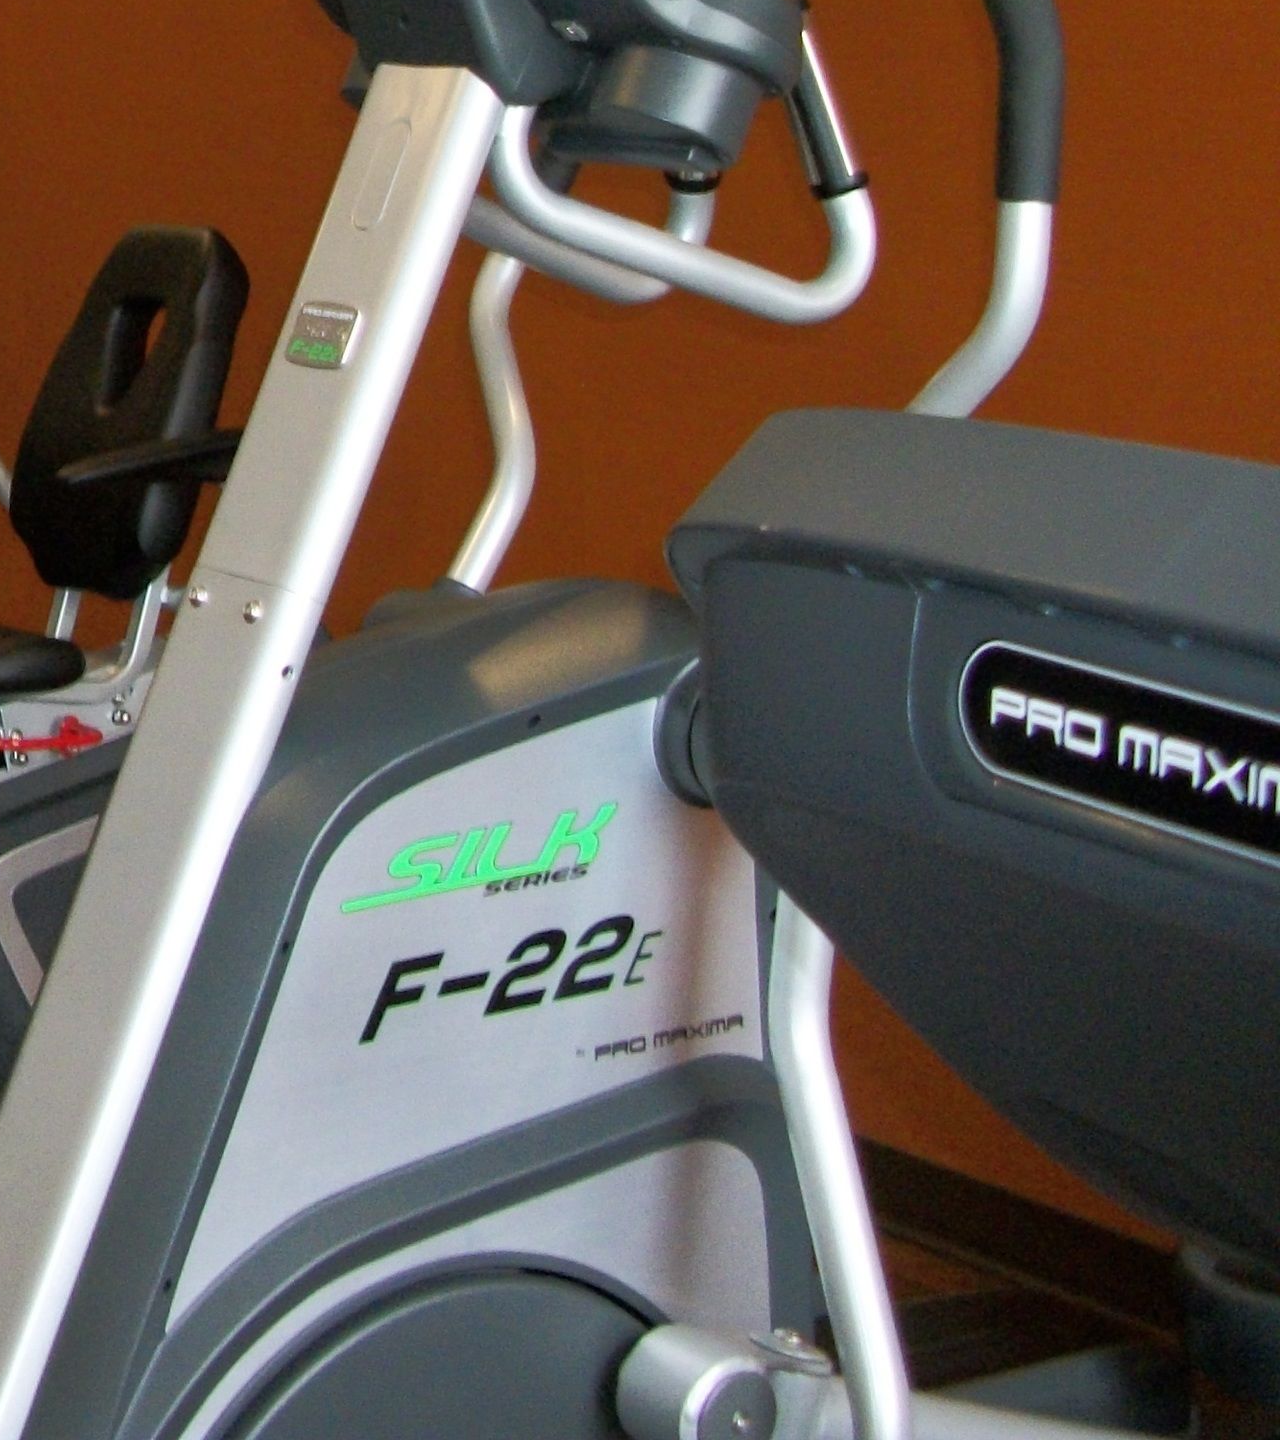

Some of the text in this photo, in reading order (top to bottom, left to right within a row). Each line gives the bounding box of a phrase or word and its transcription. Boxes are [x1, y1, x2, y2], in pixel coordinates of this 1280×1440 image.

[991, 685, 1107, 759] PRO
[341, 802, 619, 914] SILK
[483, 863, 590, 898] SERIES
[594, 1035, 647, 1061] PRO
[653, 1014, 744, 1048] MAXIMA
